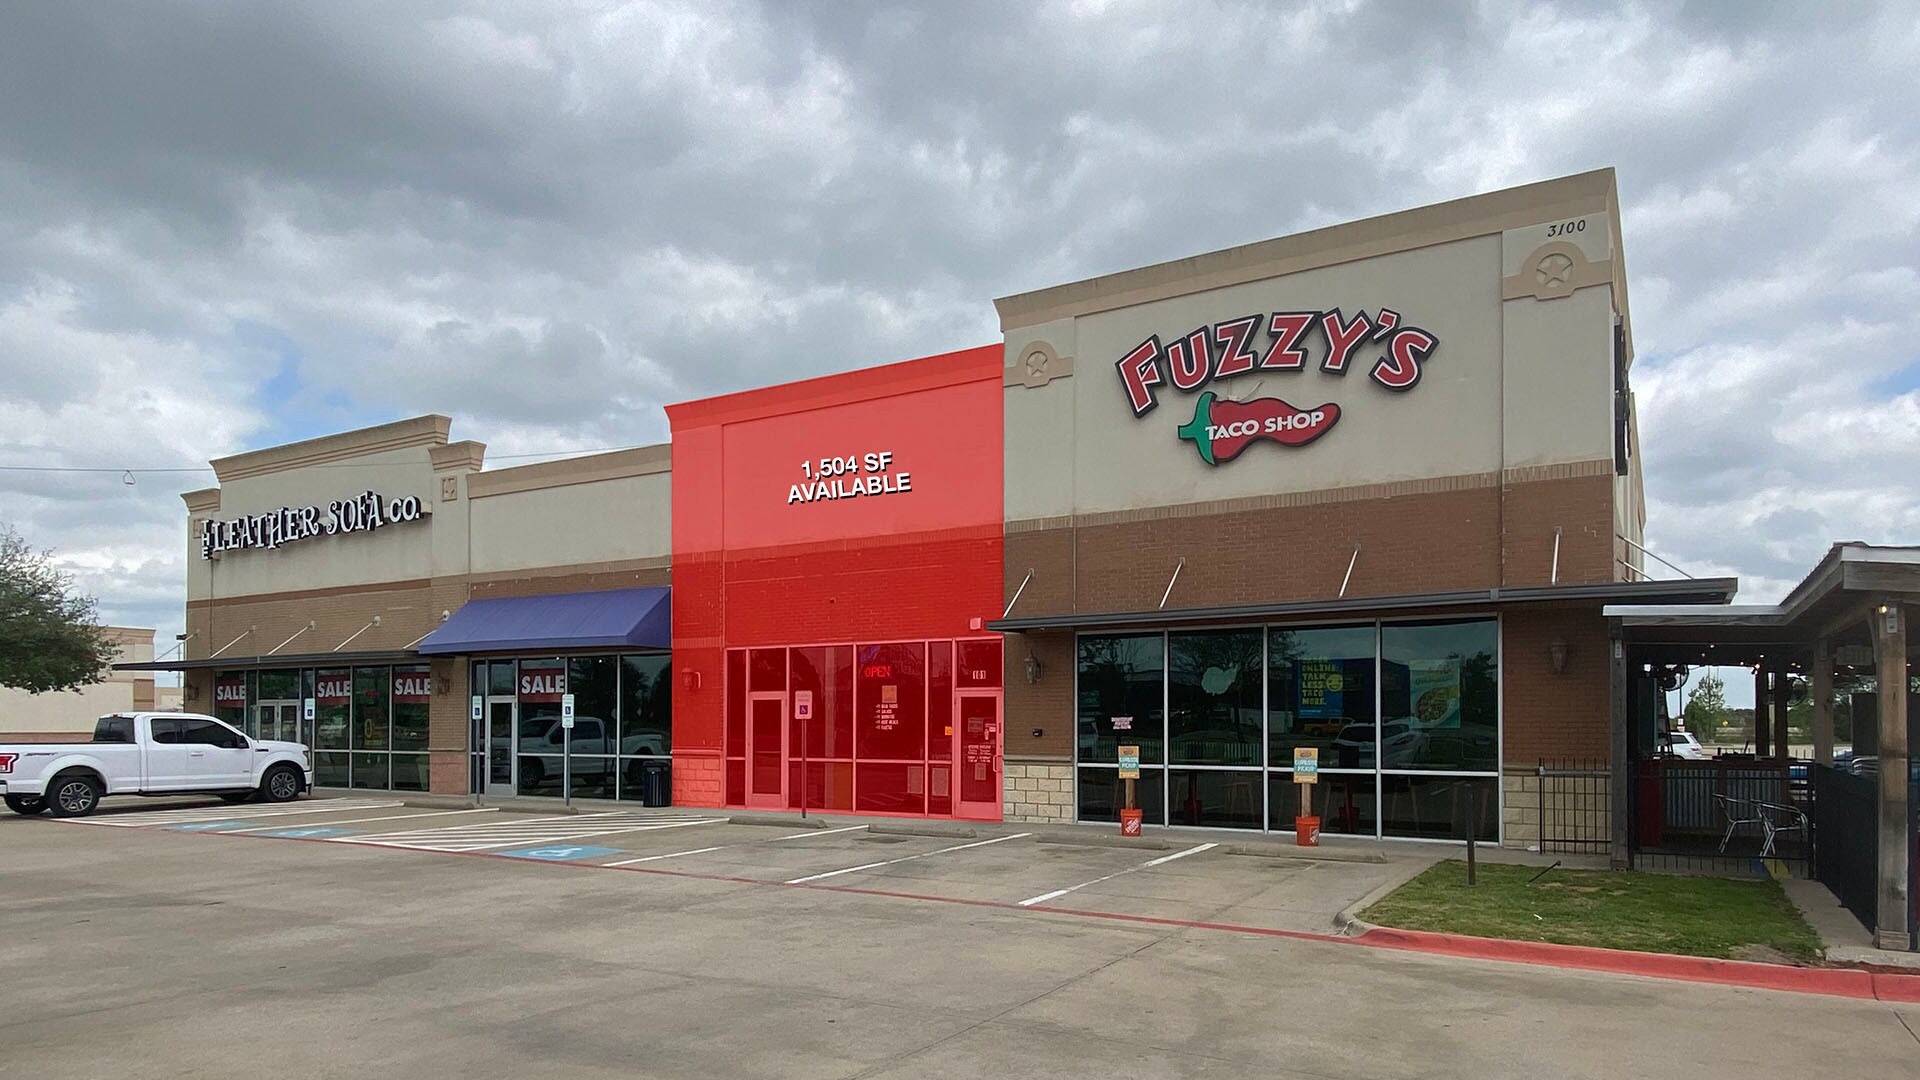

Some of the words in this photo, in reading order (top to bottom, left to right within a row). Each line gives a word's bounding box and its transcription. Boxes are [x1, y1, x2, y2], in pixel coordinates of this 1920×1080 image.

[1547, 219, 1586, 237] 3100
[1115, 307, 1440, 419] FUZZY'S
[1205, 420, 1260, 441] TACO
[1264, 411, 1325, 434] SHOP
[212, 505, 322, 552] LEATHER
[326, 489, 384, 535] SOFA
[201, 519, 213, 560] THE
[864, 666, 891, 678] OPEN
[217, 685, 246, 701] SALE
[317, 680, 351, 698] SALE
[394, 678, 431, 696] SALE
[521, 674, 565, 694] SALE
